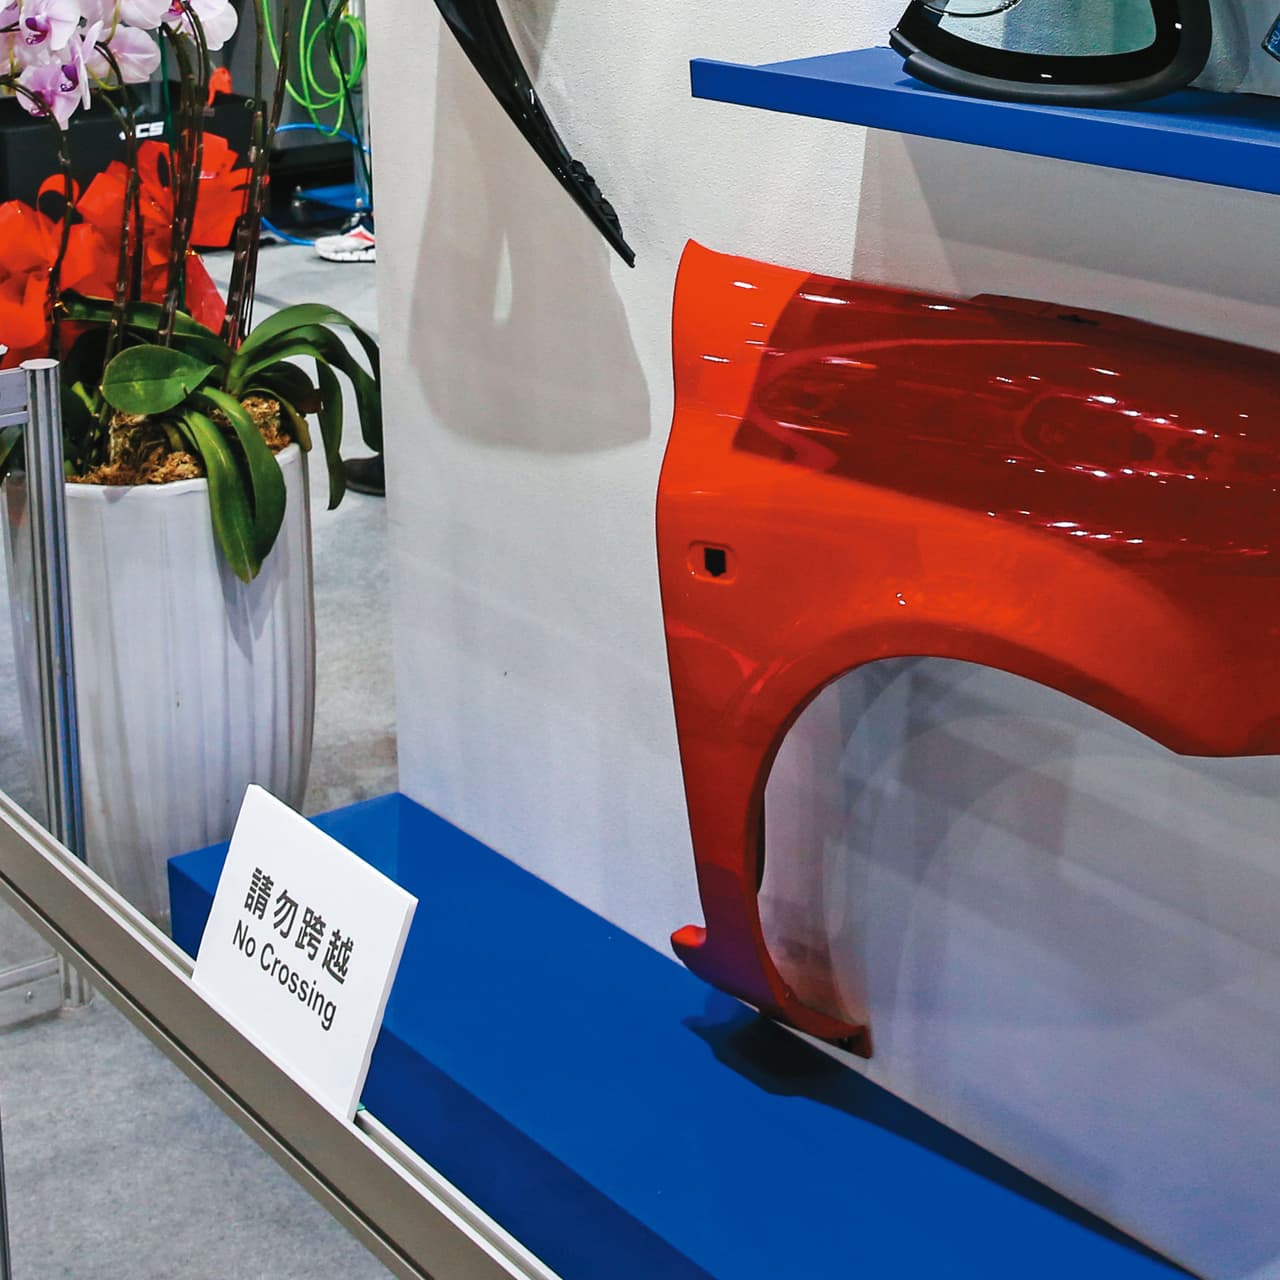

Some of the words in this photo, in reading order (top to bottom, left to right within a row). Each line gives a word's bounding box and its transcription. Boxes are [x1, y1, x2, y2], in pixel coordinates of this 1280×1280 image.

[232, 919, 257, 959] No
[259, 942, 337, 1032] Crossing
[243, 867, 354, 985] 請勿跨越
